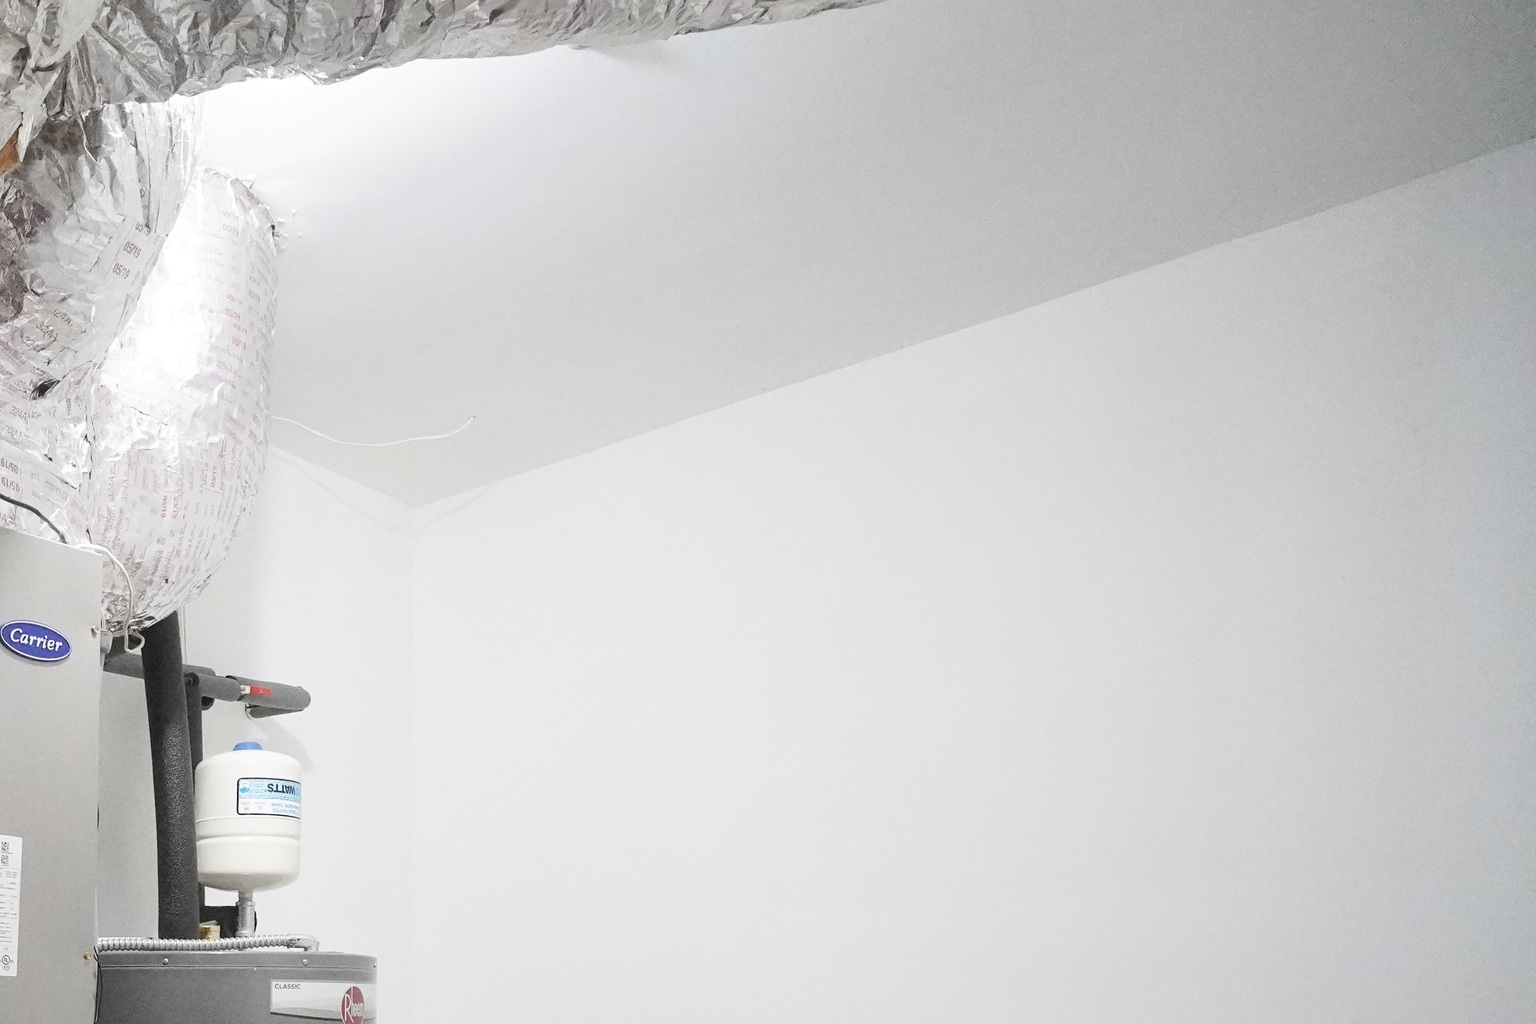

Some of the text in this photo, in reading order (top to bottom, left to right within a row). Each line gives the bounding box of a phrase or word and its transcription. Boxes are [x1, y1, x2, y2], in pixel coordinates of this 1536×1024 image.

[123, 240, 142, 259] 05/19
[112, 262, 131, 280] 05/19
[10, 627, 63, 652] Carrier
[267, 783, 296, 795] WATTS
[344, 986, 364, 1023] Rheem
